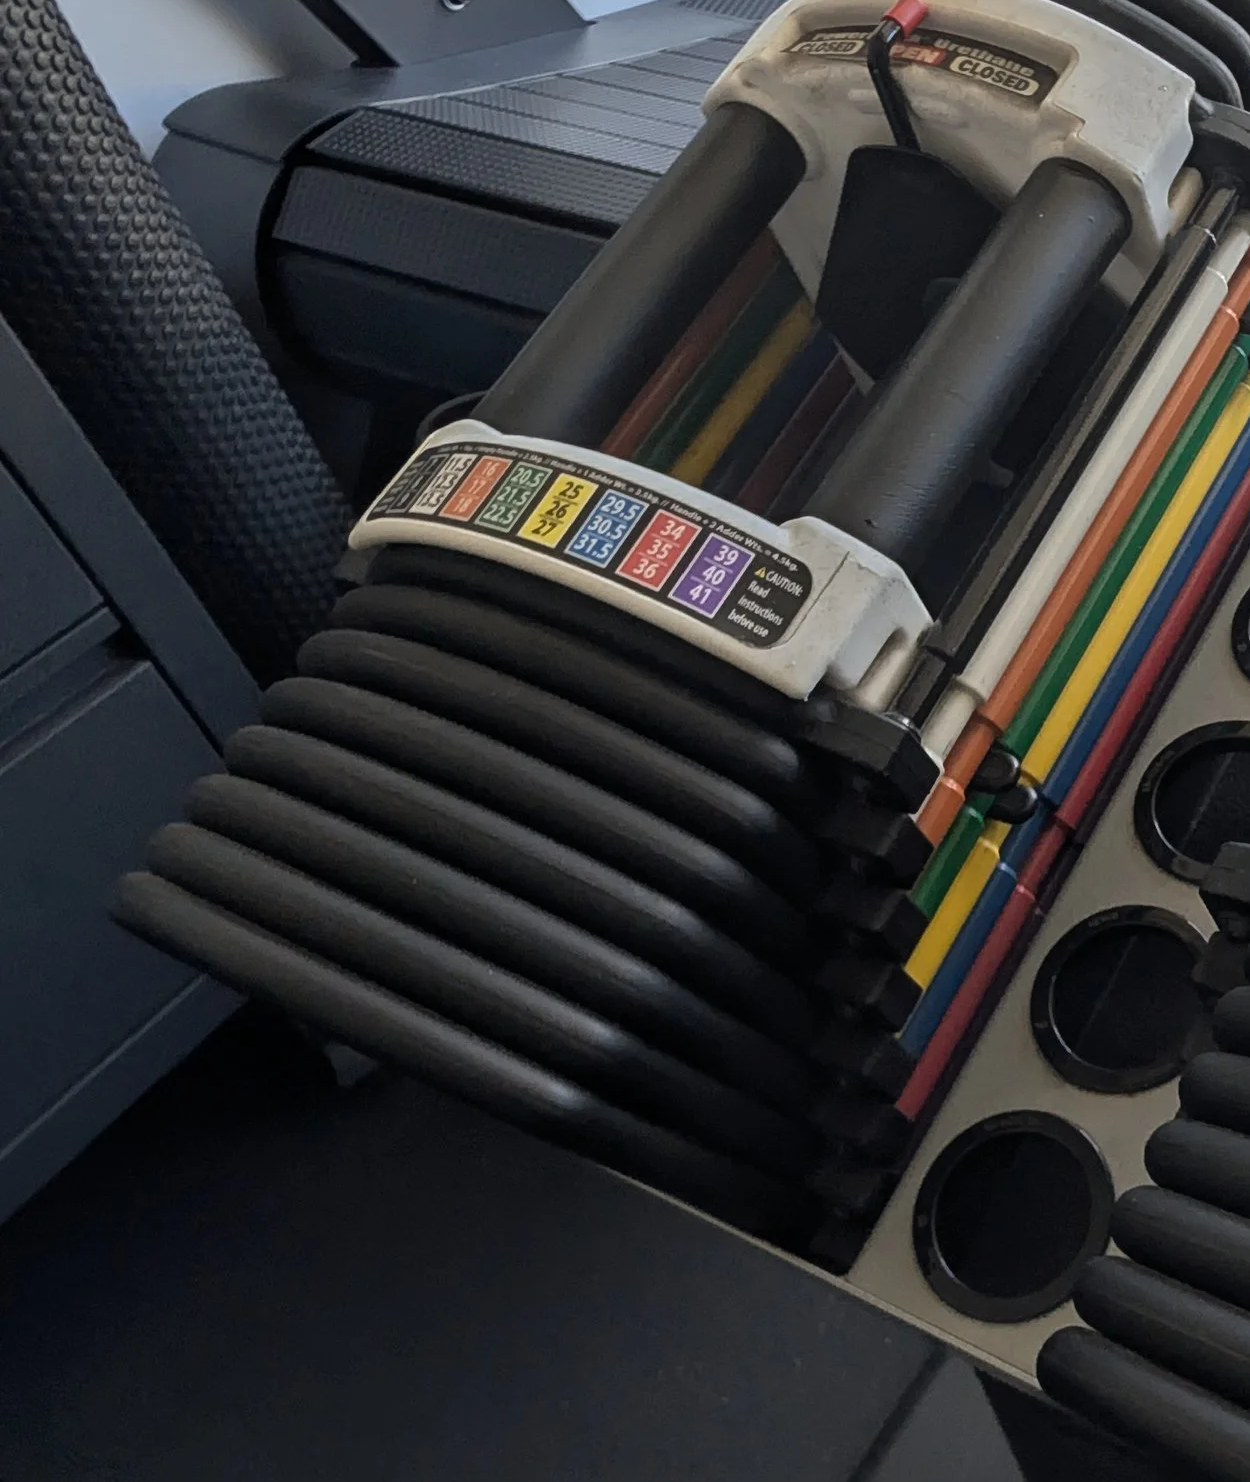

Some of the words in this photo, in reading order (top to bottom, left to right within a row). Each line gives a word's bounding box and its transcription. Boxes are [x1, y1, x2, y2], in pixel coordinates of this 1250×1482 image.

[889, 44, 941, 64] PEN
[958, 60, 1030, 92] CLOSED
[482, 461, 500, 476] 16
[511, 468, 544, 487] 20.5
[497, 486, 531, 506] 21.5
[558, 481, 583, 499] 25
[483, 504, 517, 524] 22.5
[546, 500, 569, 518] 26
[601, 495, 640, 520] 29.5
[532, 519, 557, 536] 27
[588, 515, 627, 539] 30.5
[660, 520, 686, 540] 34
[574, 533, 613, 559] 31.5
[647, 539, 673, 559] 35
[714, 545, 739, 566] 39
[633, 559, 659, 579] 36
[702, 564, 726, 585] 40
[747, 580, 771, 598] Read
[765, 570, 804, 597] CAUTION:
[689, 584, 712, 605] 41
[737, 594, 784, 626] instructions
[727, 608, 754, 630] before
[753, 625, 769, 637] use
